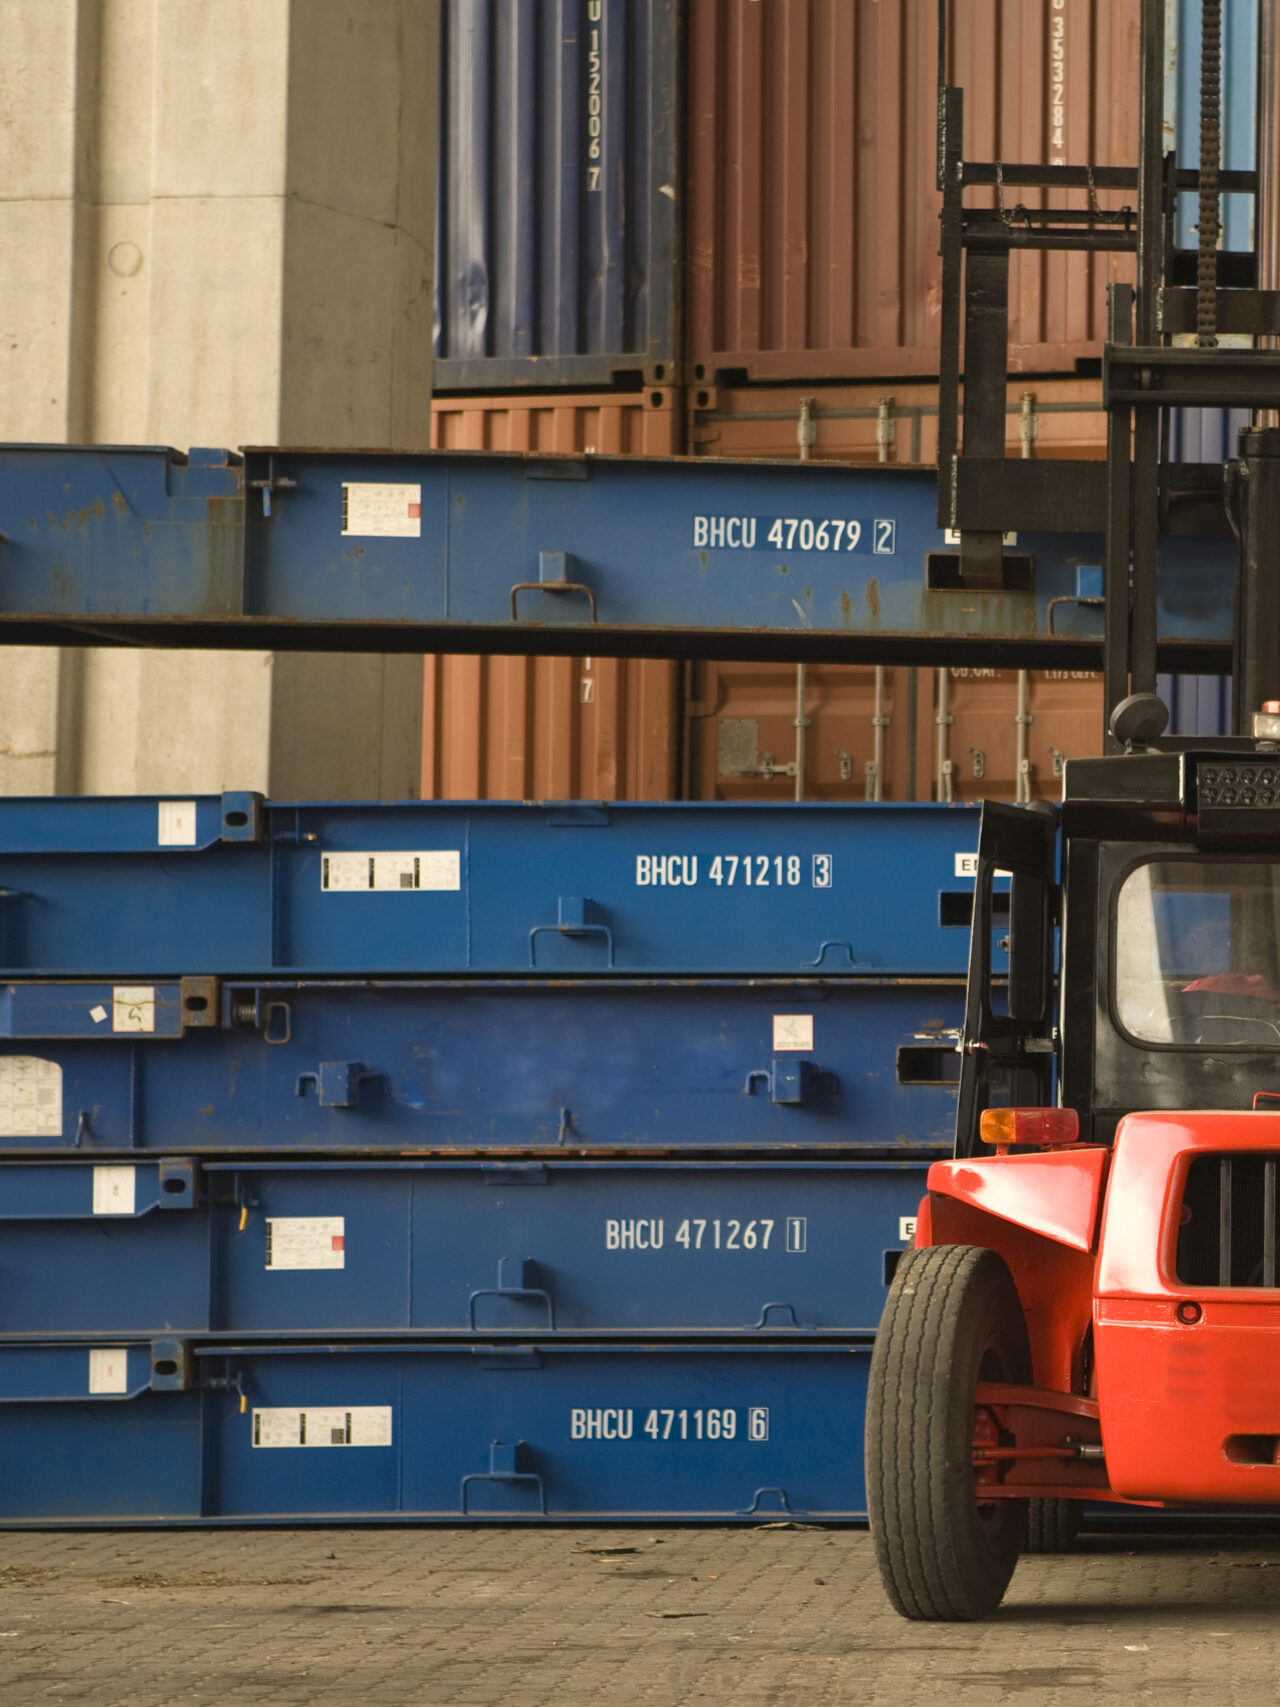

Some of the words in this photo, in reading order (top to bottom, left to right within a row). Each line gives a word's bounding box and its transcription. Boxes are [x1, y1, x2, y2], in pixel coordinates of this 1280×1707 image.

[588, 29, 600, 159] 152006
[1052, 16, 1064, 149] 353284
[587, 168, 600, 190] 7
[694, 516, 756, 548] BHCU
[767, 518, 861, 551] 470679
[875, 521, 894, 553] 2
[636, 855, 698, 886] BHCU
[708, 855, 801, 887] 471218
[814, 855, 831, 887] 3
[606, 1219, 664, 1250] BHCU
[675, 1219, 774, 1250] 471267
[571, 1408, 633, 1440] BHCU
[644, 1408, 737, 1440] 471169
[749, 1409, 768, 1440] 6
